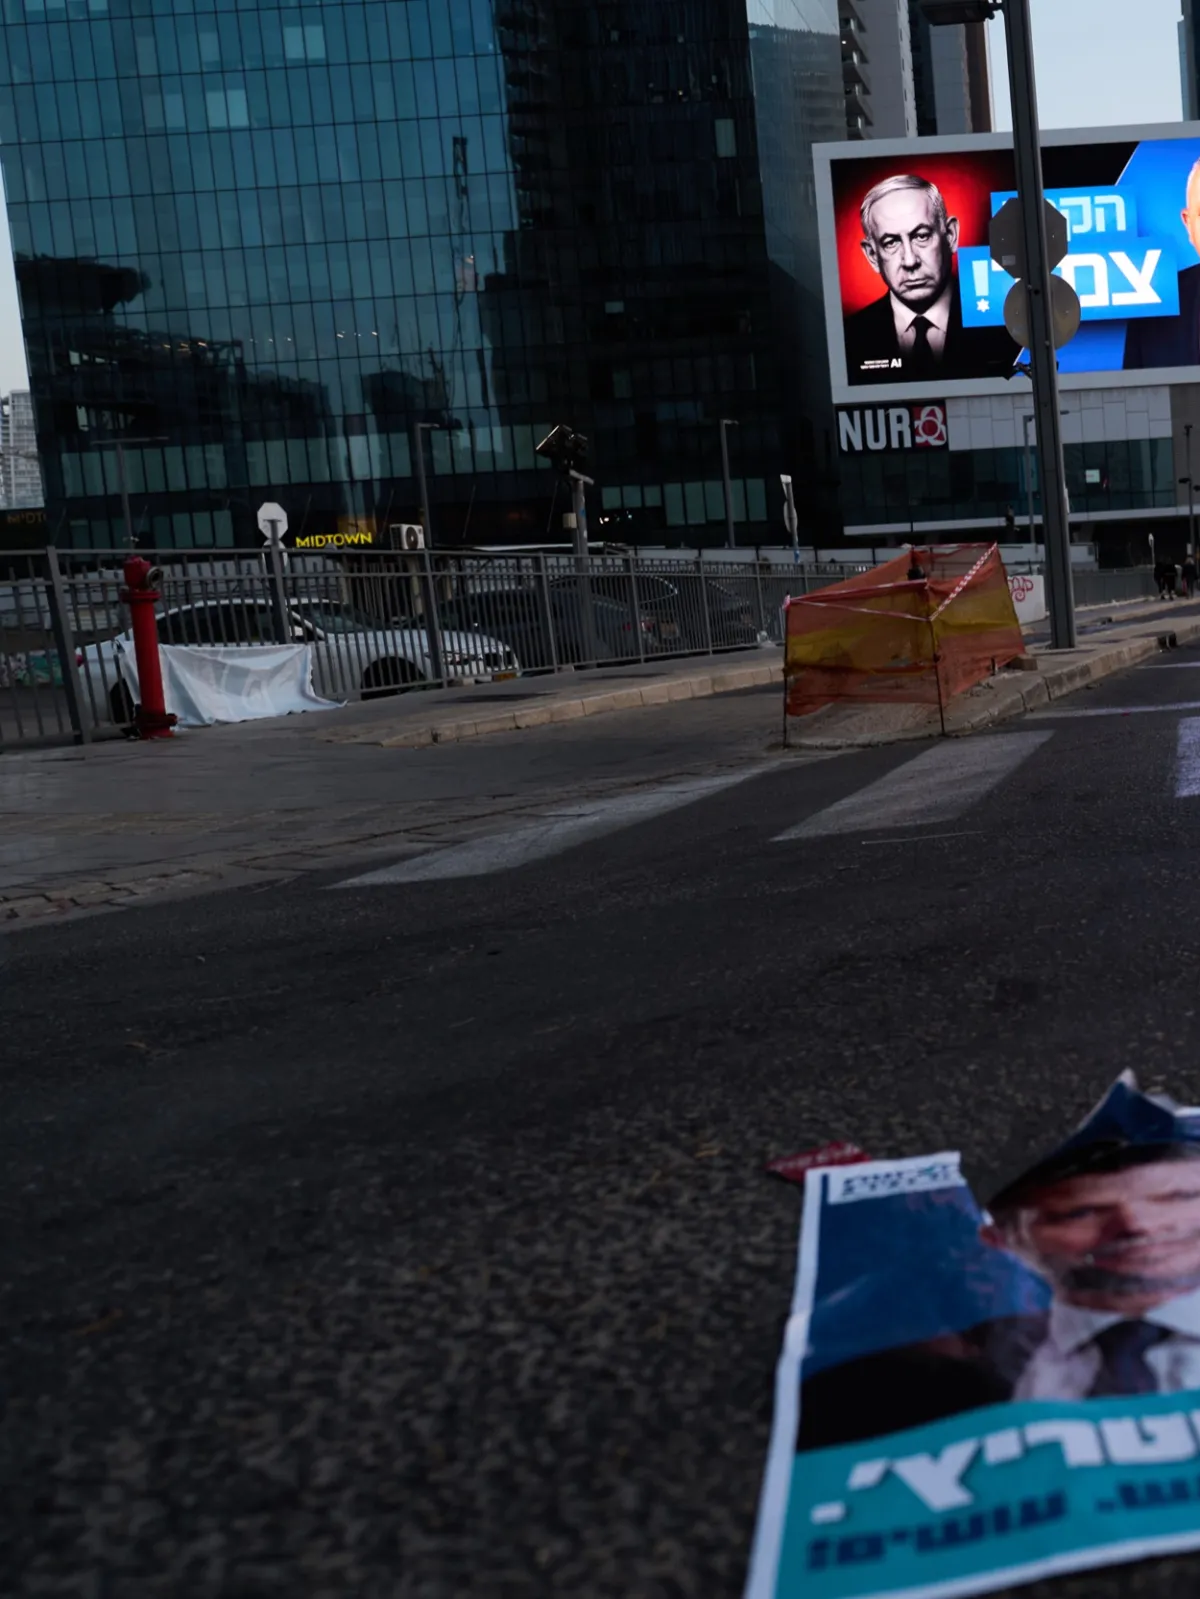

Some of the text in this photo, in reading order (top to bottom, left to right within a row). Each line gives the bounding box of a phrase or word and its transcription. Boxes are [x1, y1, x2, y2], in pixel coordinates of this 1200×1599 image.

[1003, 194, 1127, 242] הק
[838, 407, 912, 452] NUR
[295, 532, 372, 547] MIDTOWN
